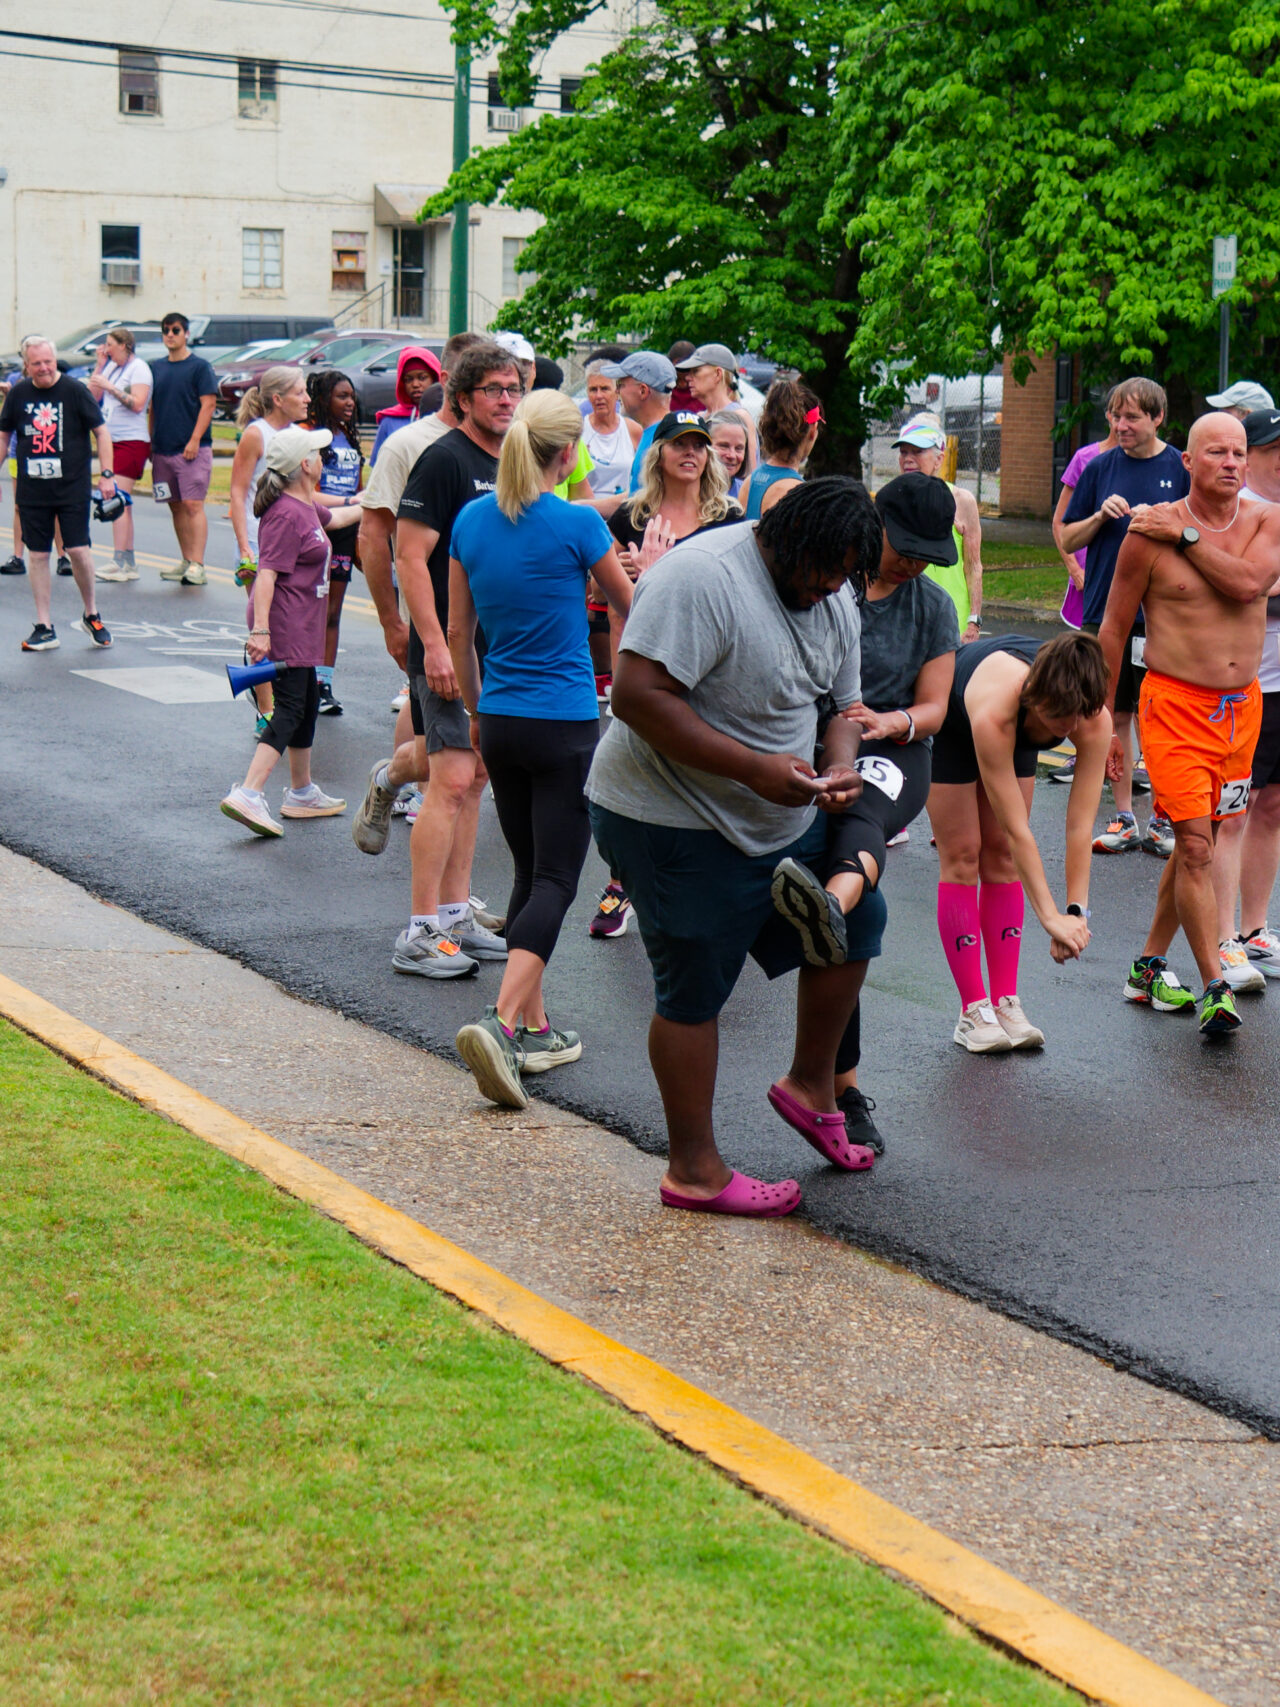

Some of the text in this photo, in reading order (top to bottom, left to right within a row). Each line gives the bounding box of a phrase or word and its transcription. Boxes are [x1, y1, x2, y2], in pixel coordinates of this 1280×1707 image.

[676, 412, 700, 425] CAT
[31, 434, 56, 454] 5K
[37, 462, 55, 476] 13
